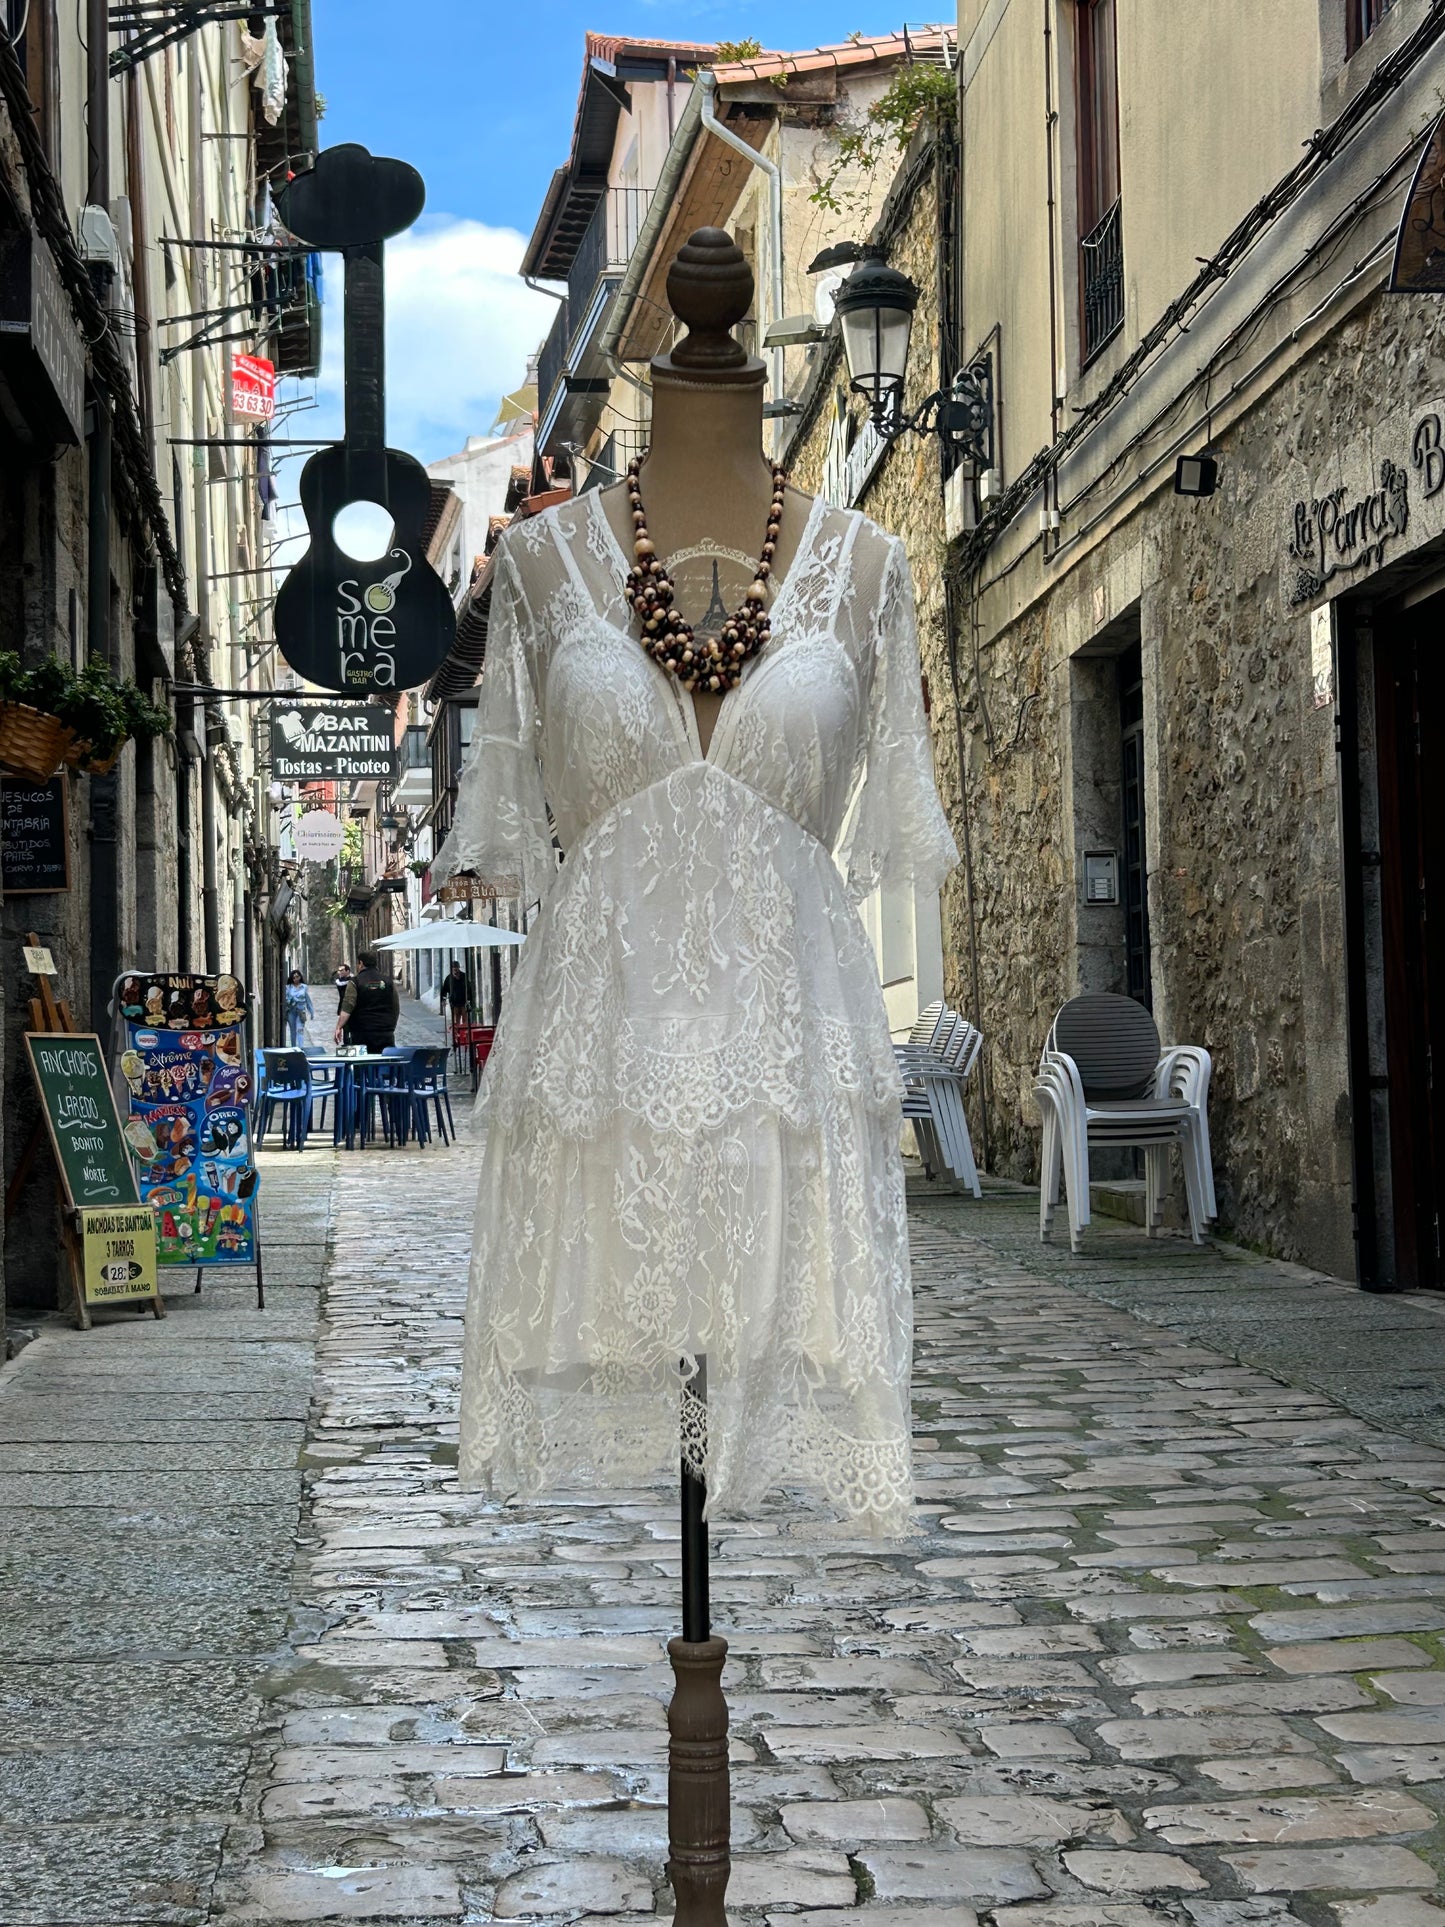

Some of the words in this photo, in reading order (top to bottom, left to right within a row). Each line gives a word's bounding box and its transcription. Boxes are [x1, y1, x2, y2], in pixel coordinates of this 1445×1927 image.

[323, 715, 369, 731] BAR
[300, 734, 390, 752] MAZANTINI
[276, 757, 322, 775] Tostas
[336, 757, 391, 775] Picoteo
[7, 804, 23, 816] DE
[40, 1049, 98, 1078] ANCHOAS
[58, 1094, 99, 1119] LAREDO
[71, 1135, 104, 1152] BONITO
[83, 1166, 108, 1182] NORTE
[87, 1215, 116, 1234] ANCHOAS
[116, 1215, 125, 1233] DE
[125, 1211, 153, 1233] SANTOÑA
[106, 1241, 111, 1258] 3
[112, 1239, 135, 1257] TARROS
[94, 1285, 124, 1296] SOBADAS
[125, 1284, 130, 1293] A
[131, 1283, 151, 1293] MANO
